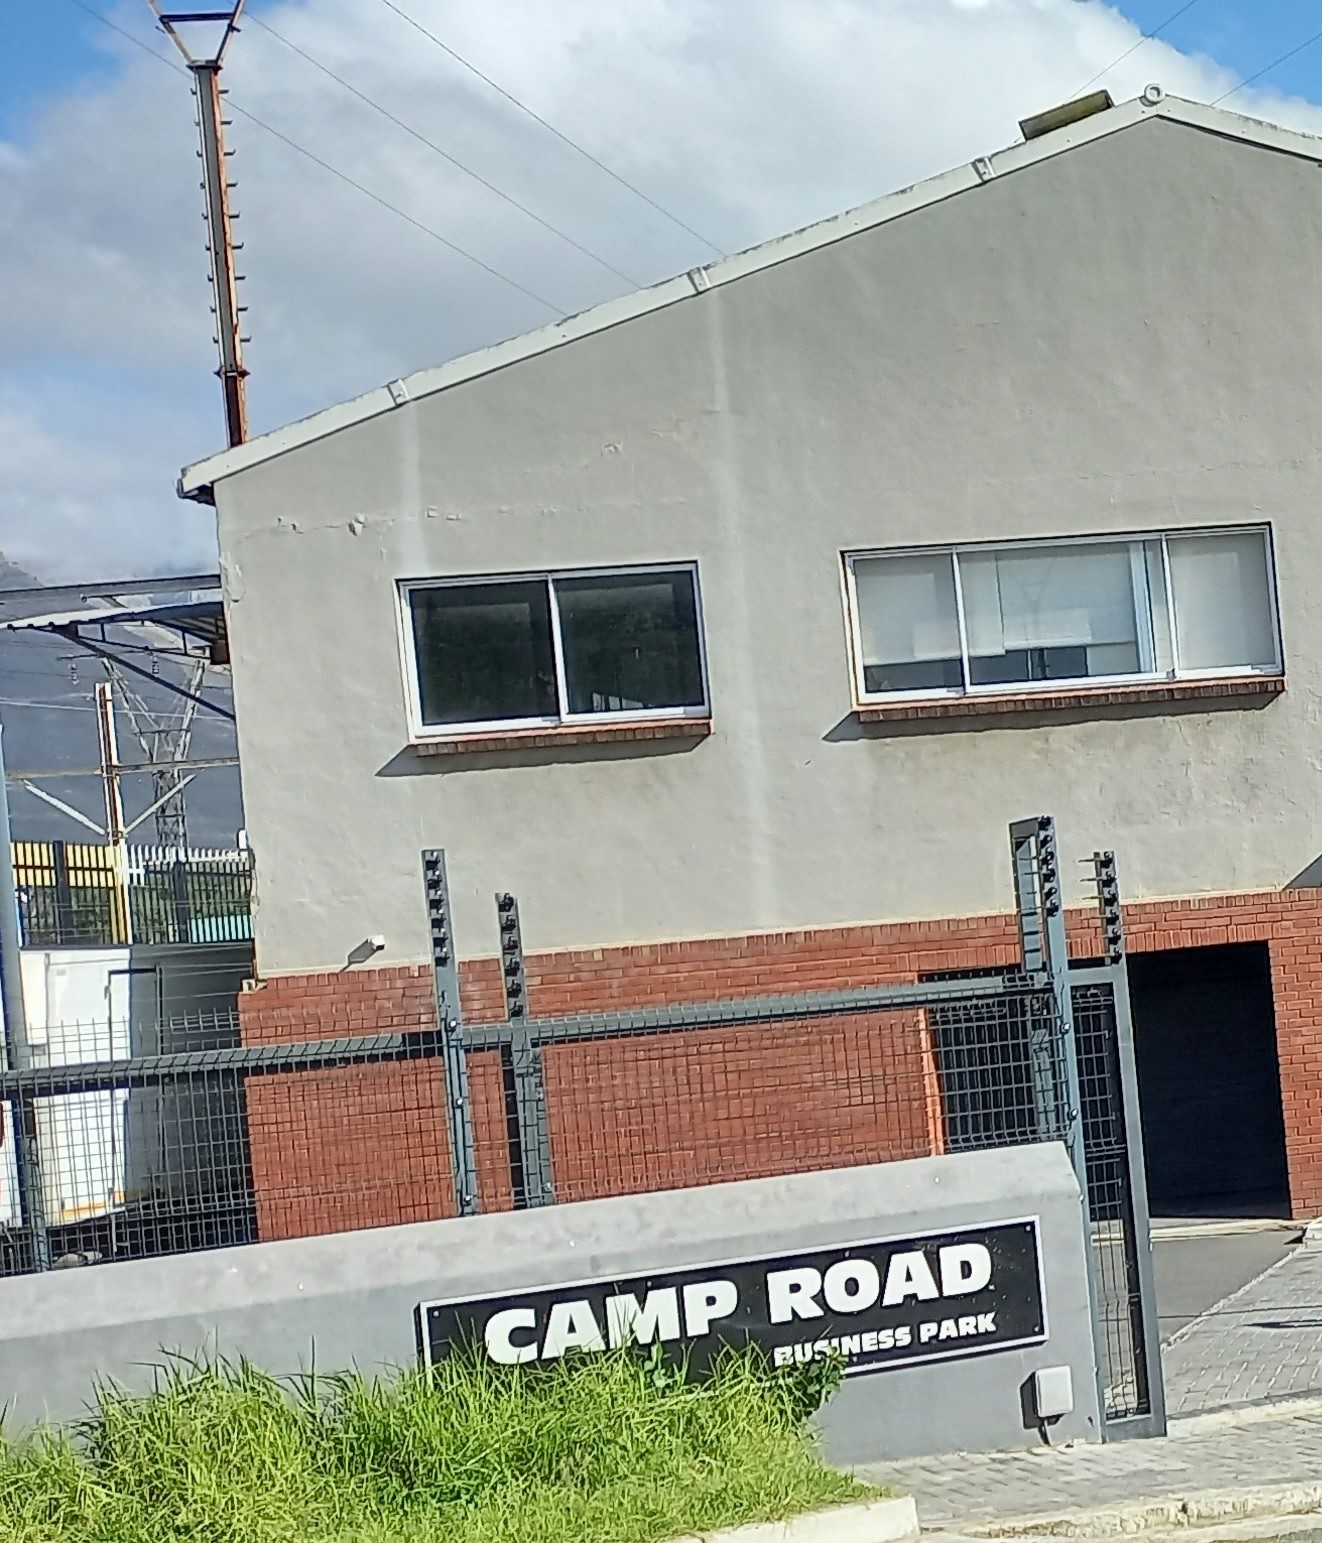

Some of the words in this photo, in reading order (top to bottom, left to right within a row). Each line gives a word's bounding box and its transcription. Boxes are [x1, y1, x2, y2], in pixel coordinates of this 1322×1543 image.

[485, 1280, 738, 1365] CAMP
[766, 1243, 993, 1324] ROAD
[919, 1311, 998, 1344] PARK
